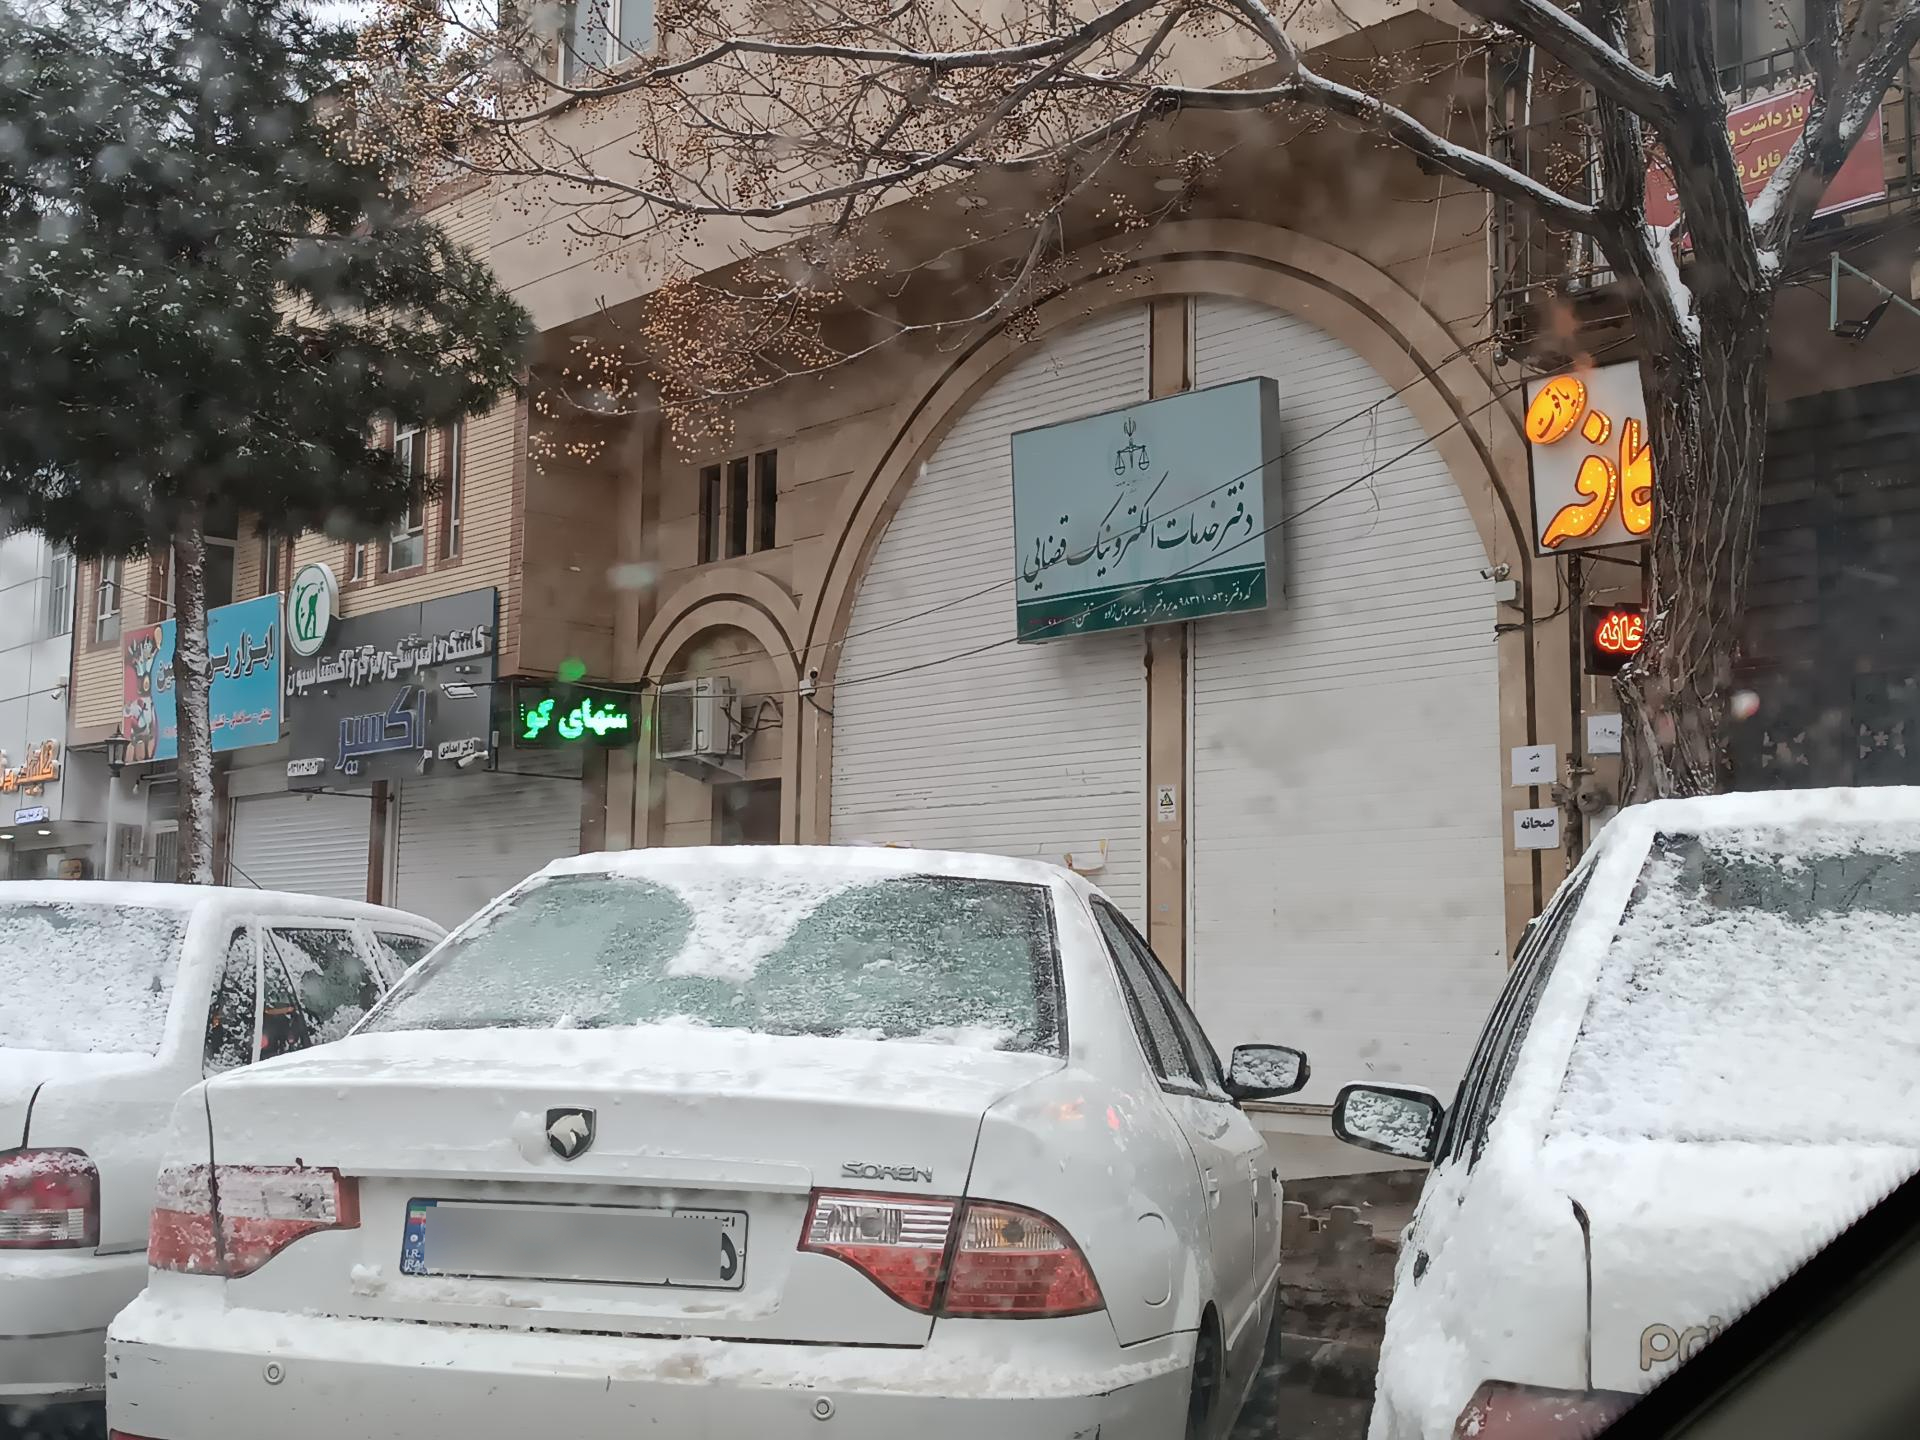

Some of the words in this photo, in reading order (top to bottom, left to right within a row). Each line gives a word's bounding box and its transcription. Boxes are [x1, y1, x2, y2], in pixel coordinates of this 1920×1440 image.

[1065, 471, 1170, 577] الکترونیک
[1156, 500, 1219, 550] خدمات
[1211, 481, 1253, 552] دفتر
[230, 621, 275, 679] ابزار
[445, 625, 485, 673] کلینیک
[334, 684, 427, 776] اکسیر
[1520, 816, 1555, 832] صبحانه
[841, 1160, 934, 1183] SOREN
